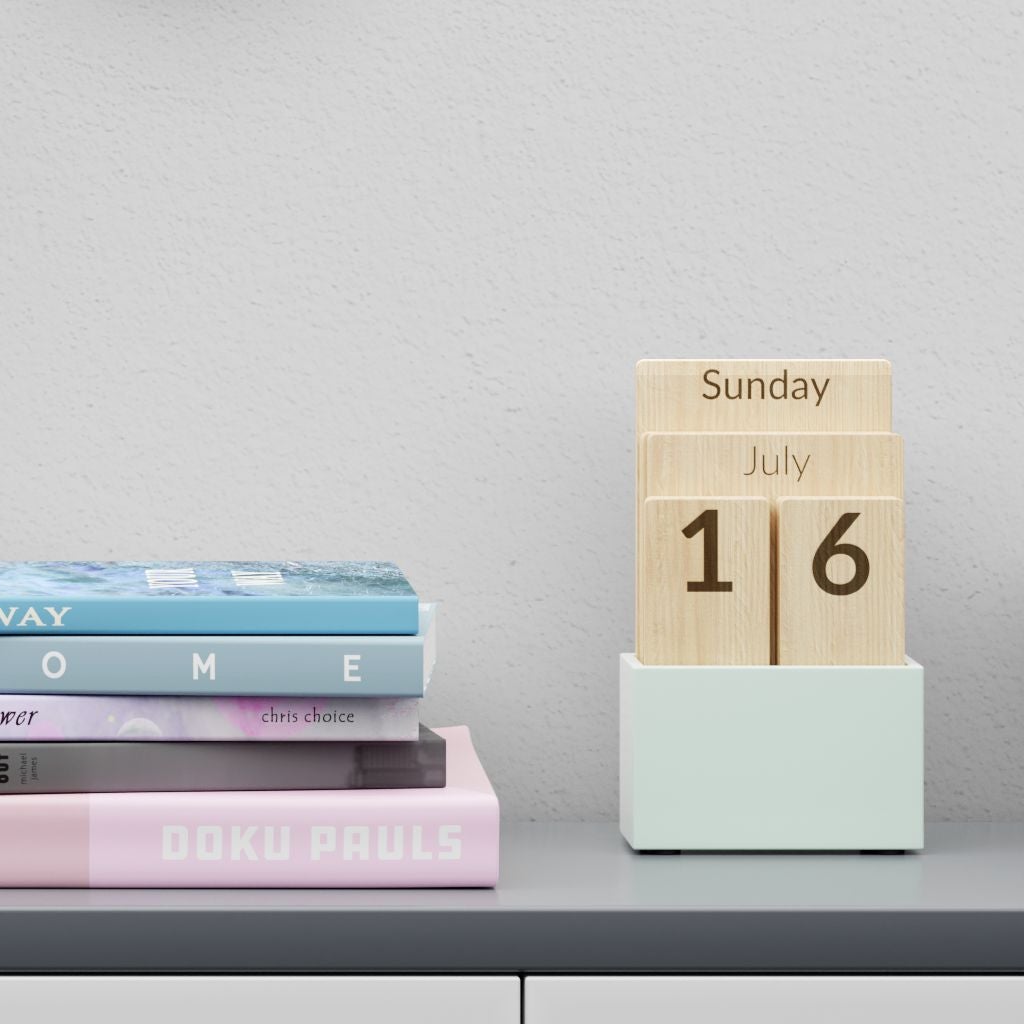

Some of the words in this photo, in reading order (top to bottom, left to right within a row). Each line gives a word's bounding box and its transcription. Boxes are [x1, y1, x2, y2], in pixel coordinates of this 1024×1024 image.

[701, 368, 830, 407] Sunday
[743, 445, 811, 482] July
[681, 509, 733, 592] 1
[812, 512, 870, 596] 6
[261, 707, 298, 724] chris
[304, 707, 356, 724] choice
[18, 752, 28, 785] michael
[30, 756, 39, 781] james
[162, 825, 291, 861] DOKU
[310, 825, 463, 861] PAULS
